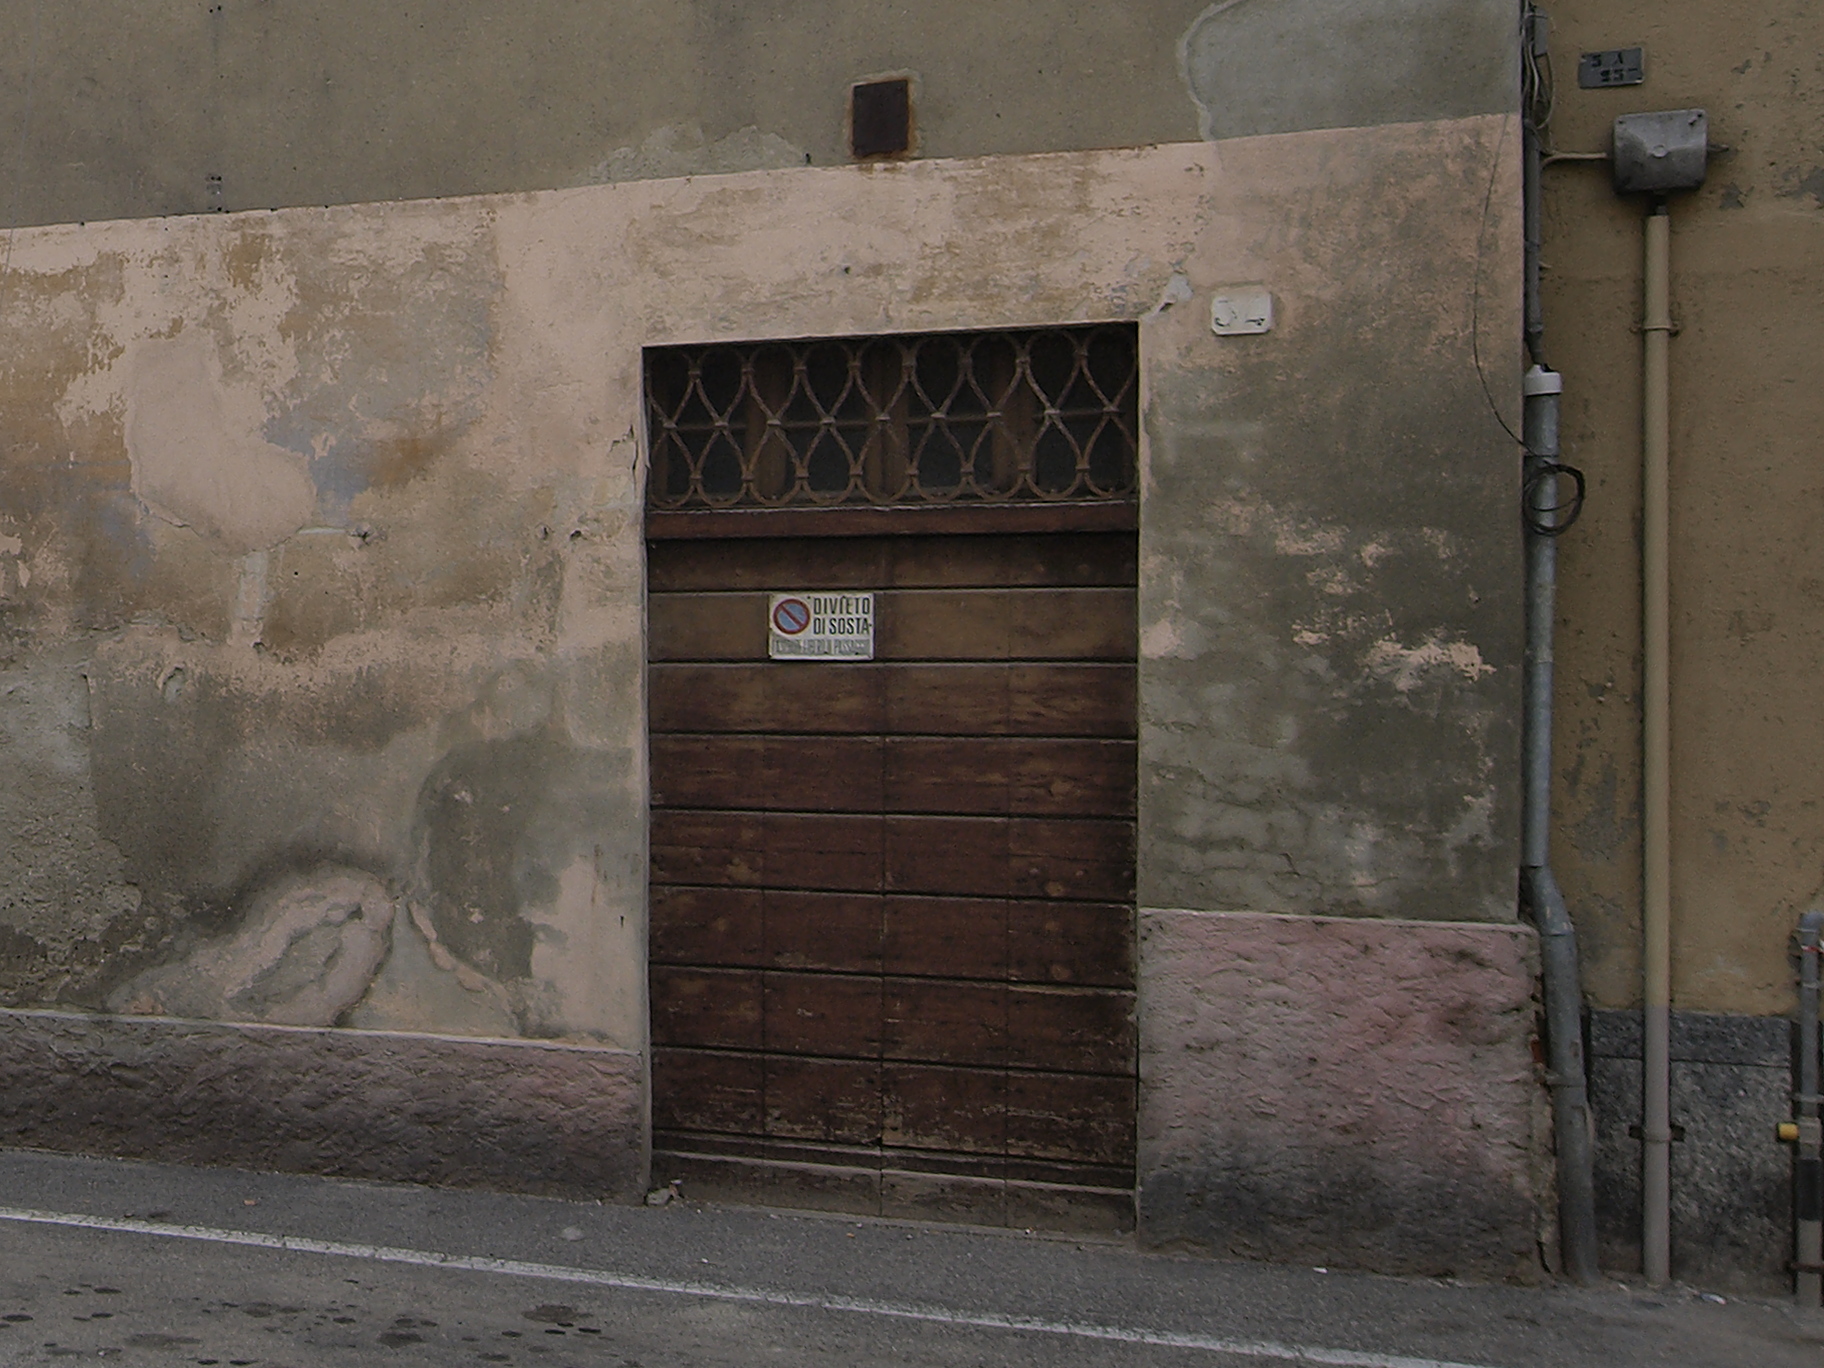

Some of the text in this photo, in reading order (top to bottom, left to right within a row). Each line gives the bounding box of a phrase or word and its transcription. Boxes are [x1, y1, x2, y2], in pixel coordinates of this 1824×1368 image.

[813, 598, 870, 615] DIVIETO
[813, 618, 869, 635] DI SOSTA
